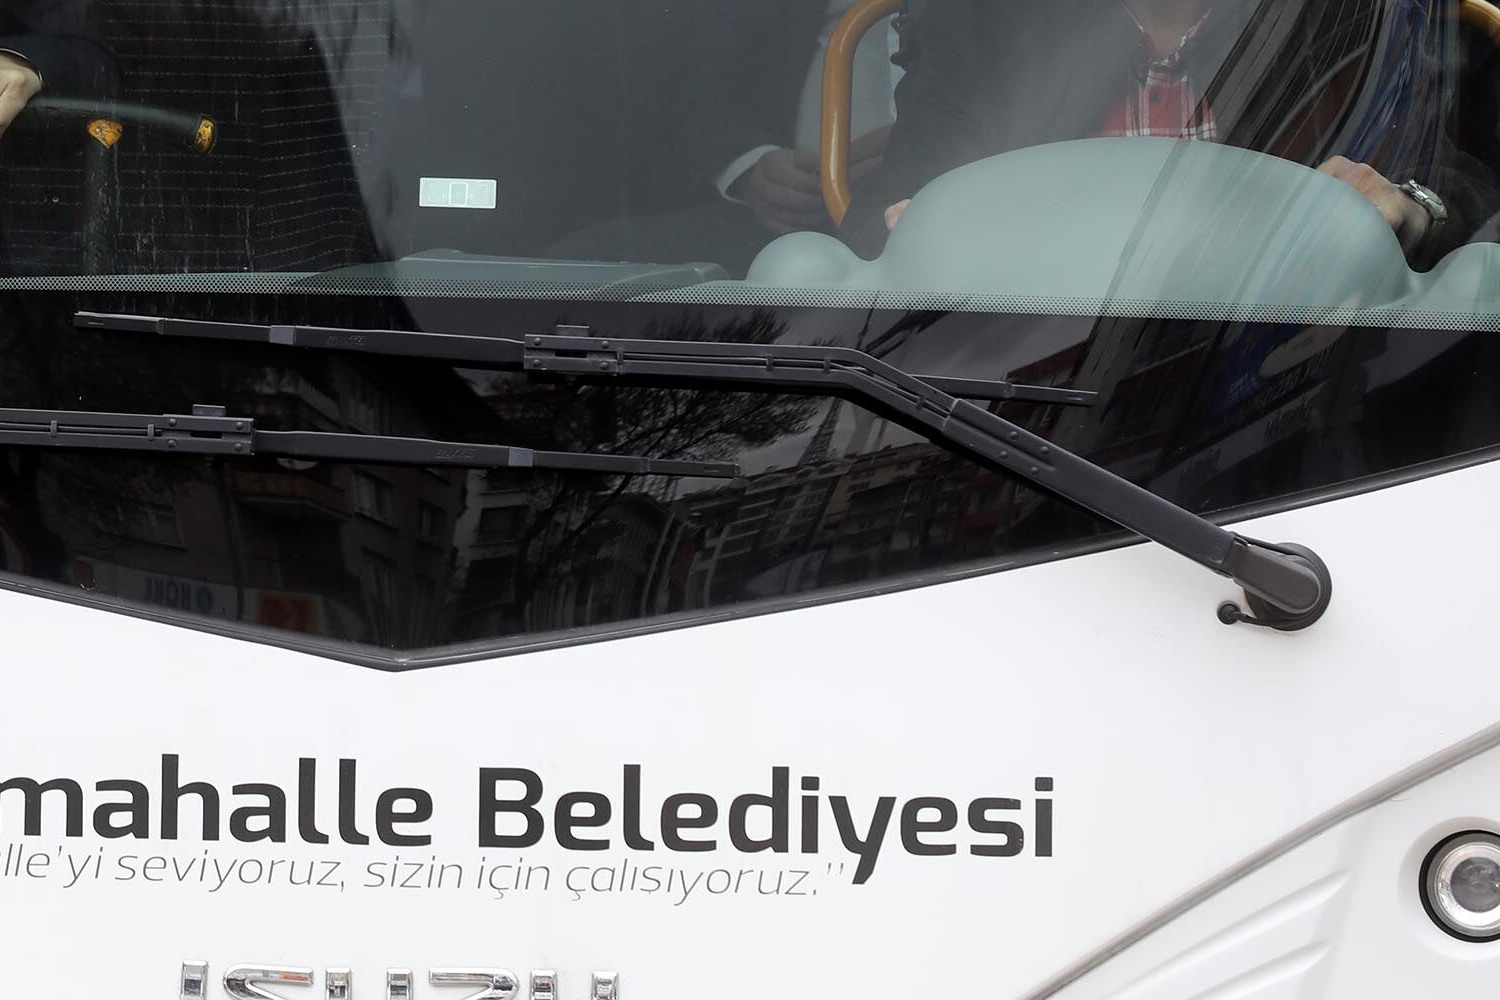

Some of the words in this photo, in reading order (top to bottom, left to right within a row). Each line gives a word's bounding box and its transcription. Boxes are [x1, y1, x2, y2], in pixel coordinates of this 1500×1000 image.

[477, 763, 1054, 886] Belediyesi
[114, 848, 345, 894] seviyoruz,
[363, 855, 463, 889] sizin
[477, 855, 551, 901] için
